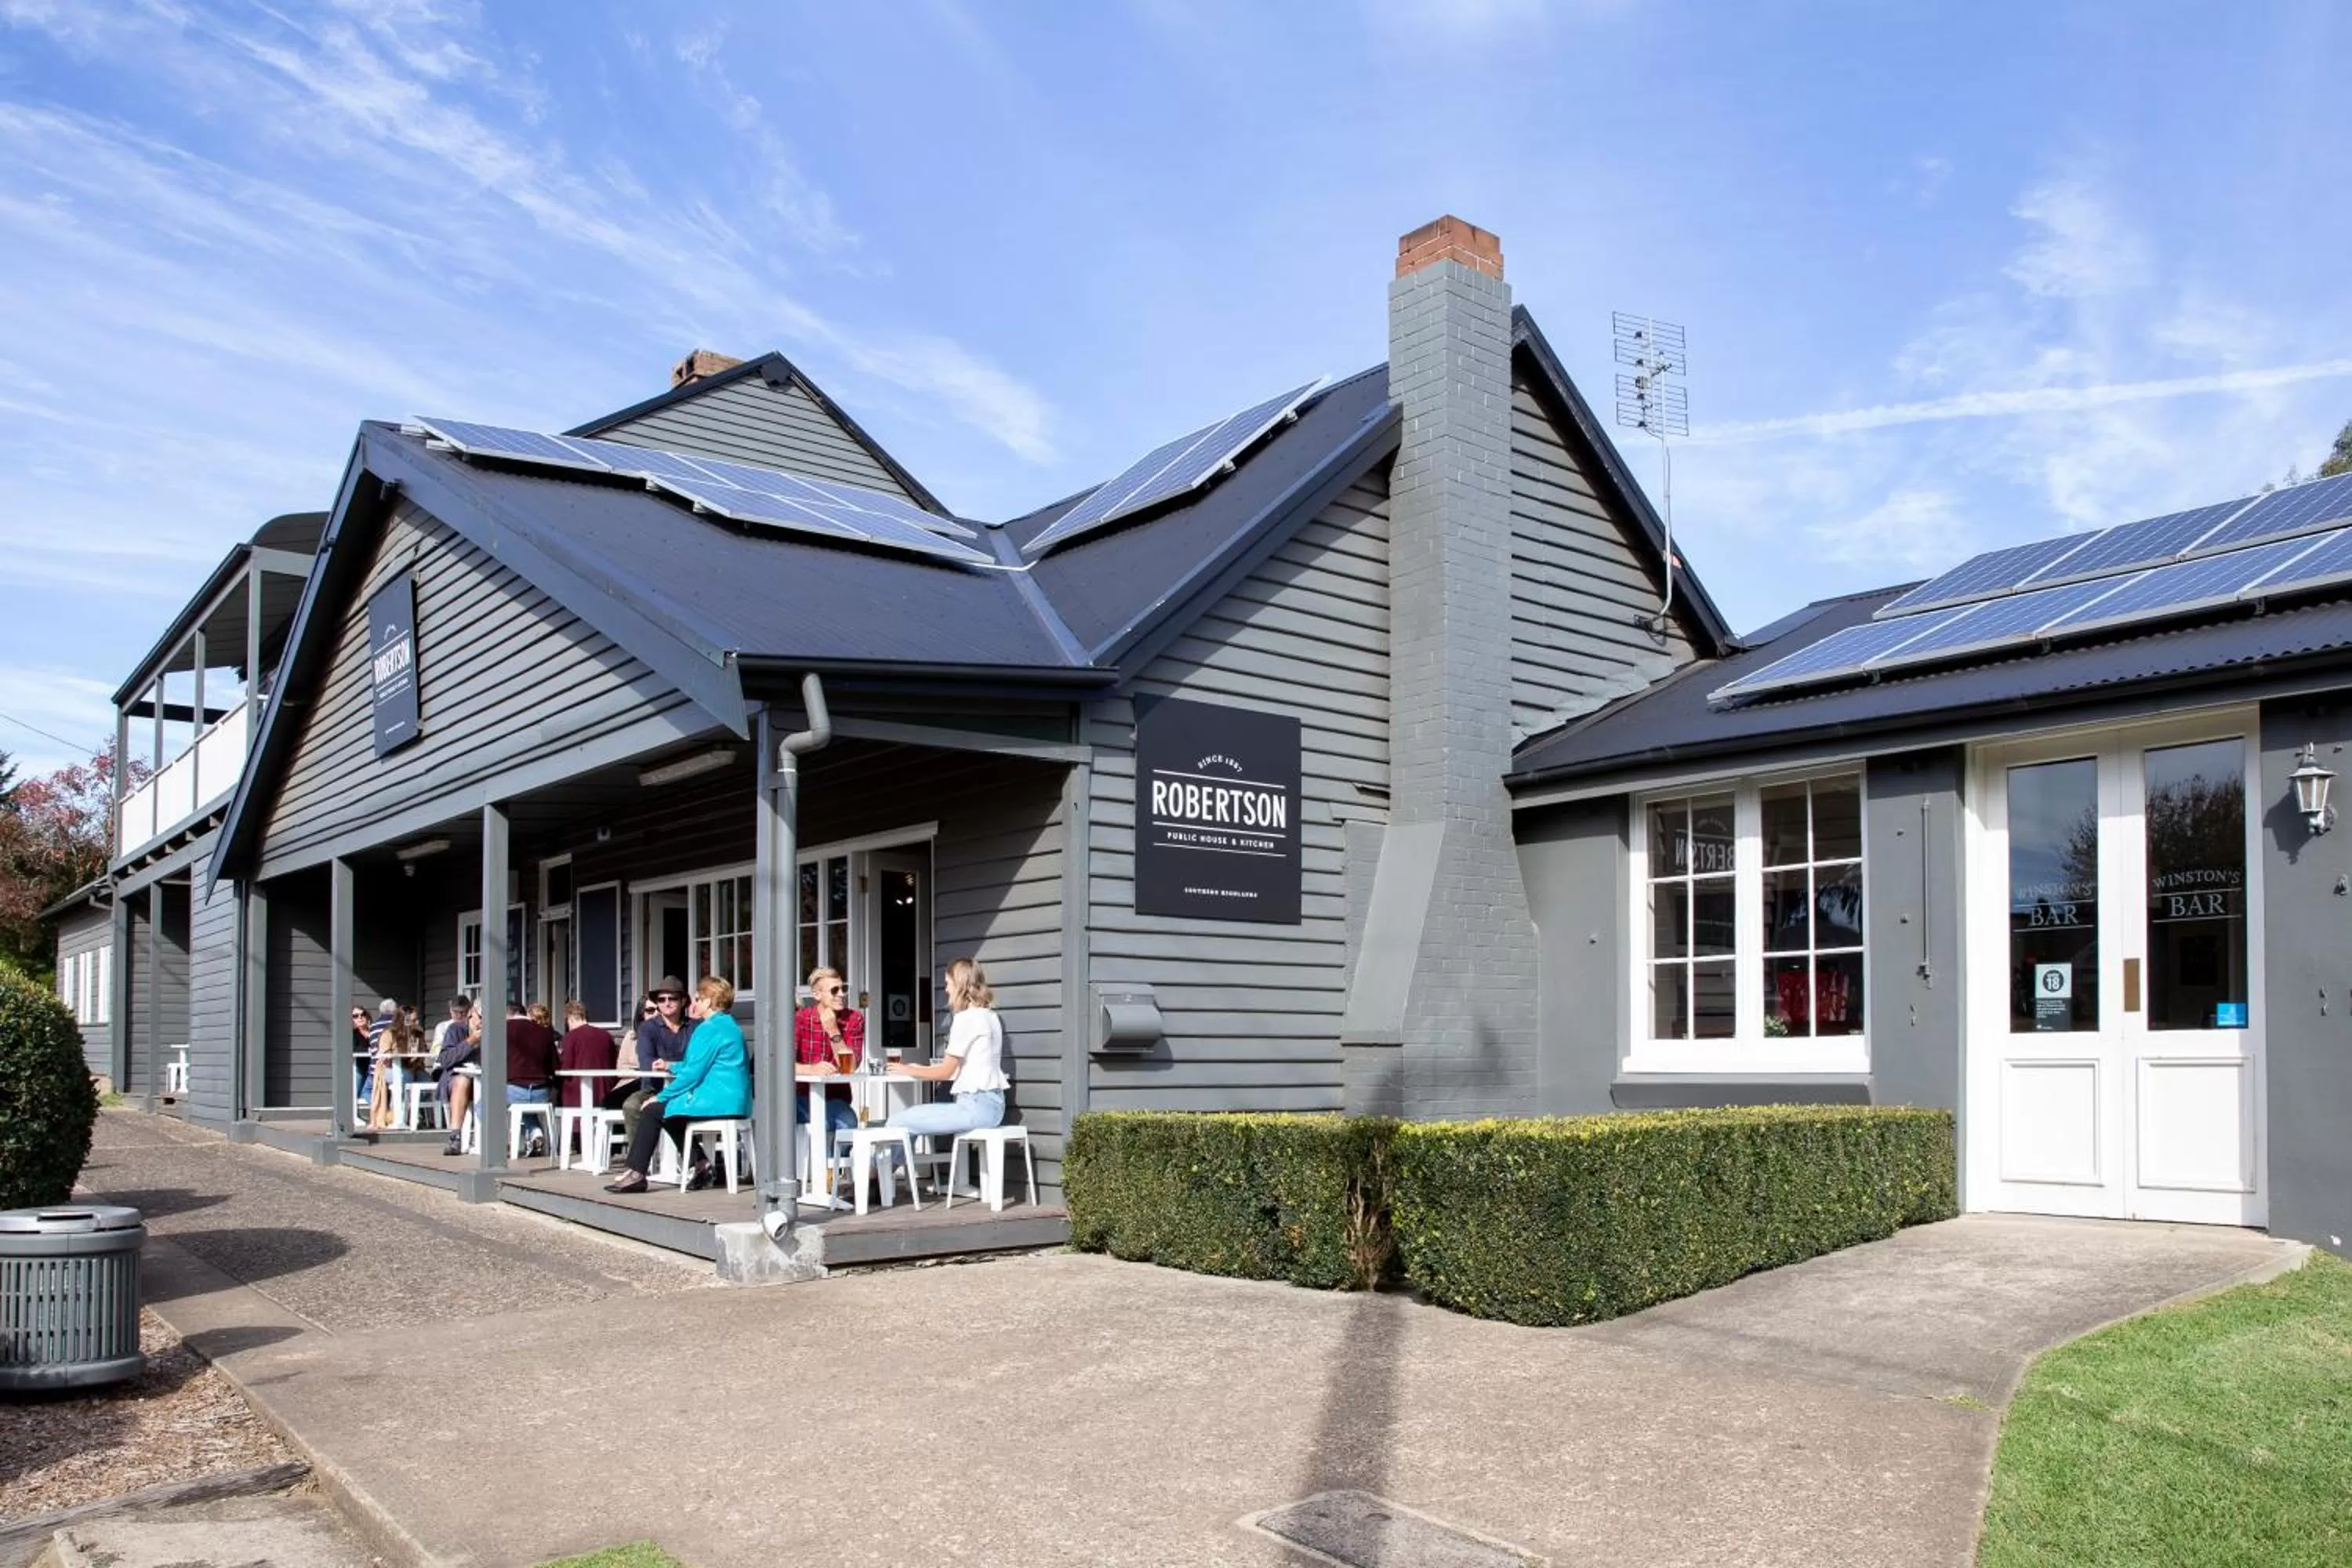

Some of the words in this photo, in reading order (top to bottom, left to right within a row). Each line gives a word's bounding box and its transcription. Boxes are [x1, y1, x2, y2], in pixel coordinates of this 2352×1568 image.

[1152, 780, 1287, 829] ROBERTSON
[1167, 832, 1197, 841] PUBLIC
[1200, 835, 1227, 844] HOUSE
[1240, 839, 1274, 848] KITCHEN
[2152, 869, 2241, 888] WINSTON'S
[2029, 904, 2079, 926] BAR
[2169, 894, 2225, 916] BAR
[2046, 976, 2060, 989] 18
